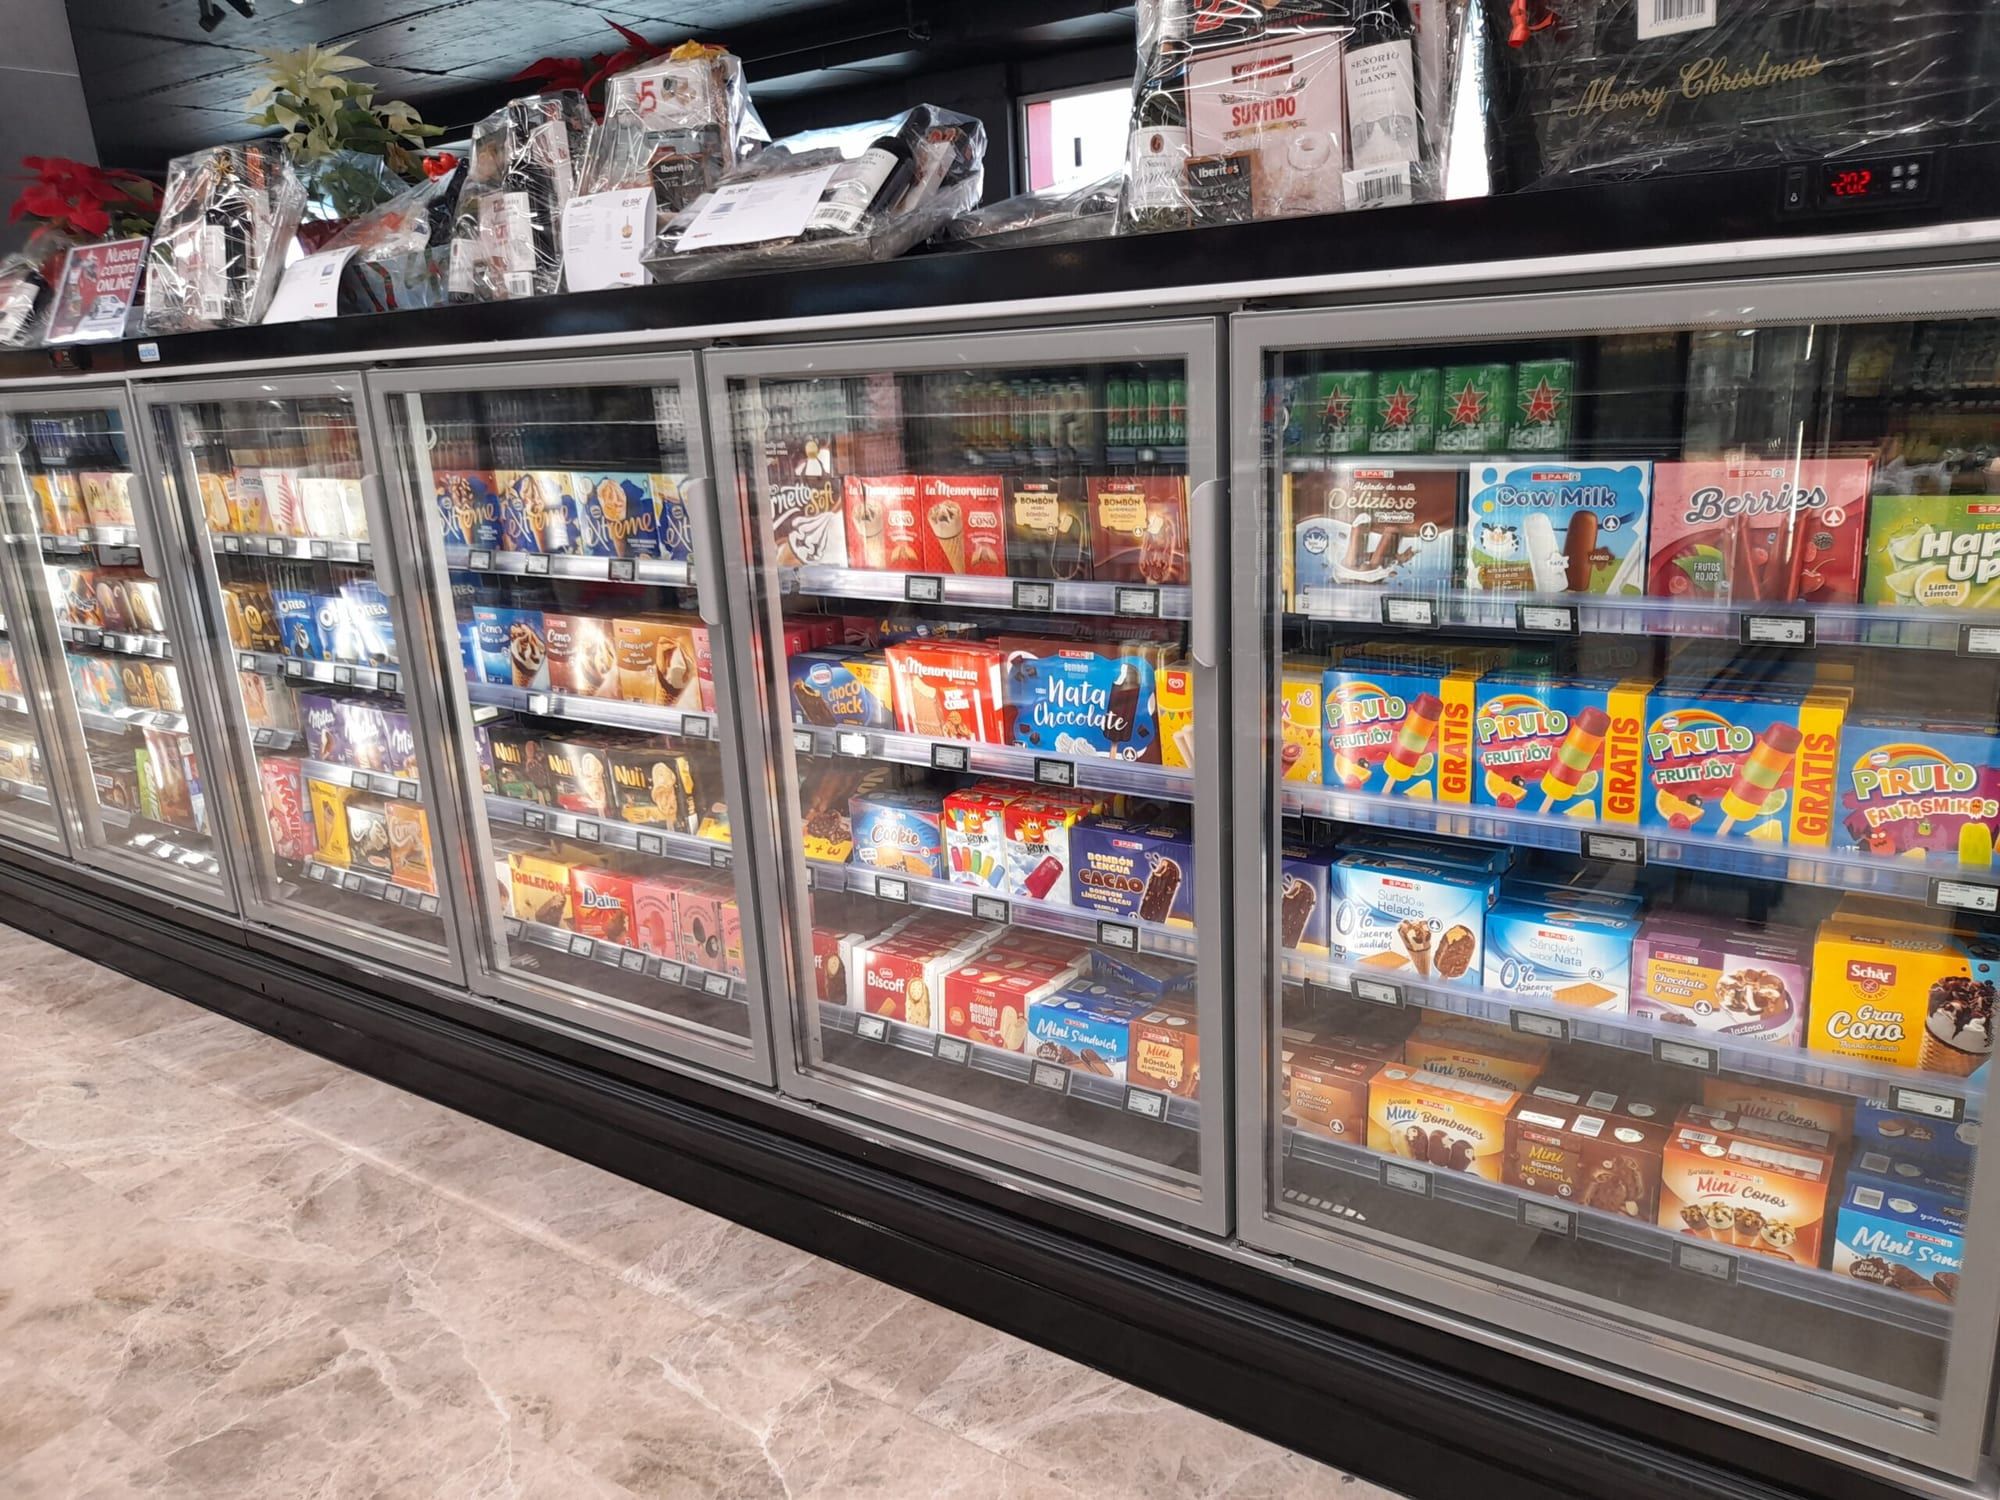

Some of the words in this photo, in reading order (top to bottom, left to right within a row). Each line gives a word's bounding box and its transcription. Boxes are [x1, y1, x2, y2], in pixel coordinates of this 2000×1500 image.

[1355, 71, 1397, 87] LLANOS
[1568, 76, 1668, 117] Merry
[1680, 52, 1824, 98] Christmas
[1232, 96, 1296, 126] SURTIDO
[1199, 165, 1239, 178] Iberitos
[105, 247, 140, 264] Nueva
[100, 262, 136, 277] compra
[96, 276, 134, 292] ONLINE
[1540, 473, 1569, 482] SPAR
[1737, 469, 1771, 478] SPAR
[805, 481, 836, 517] Soft
[935, 480, 999, 499] Menorquina
[1328, 488, 1417, 510] Delizioso
[1496, 485, 1556, 509] Cow
[1560, 485, 1617, 509] Milk
[1020, 496, 1054, 505] BOMBÓN
[1104, 497, 1141, 506] BOMBÓN
[1684, 484, 1829, 525] Berries
[1978, 505, 2000, 513] SPA
[970, 516, 995, 527] CONO
[1920, 530, 2000, 558] Hap
[1693, 562, 1721, 572] FRUTOS
[1695, 572, 1719, 582] ROJOS
[1923, 590, 1959, 598] Limón
[1928, 583, 1956, 591] Lima
[280, 599, 307, 613] OREO
[906, 656, 978, 682] Menorquina
[828, 680, 861, 702] choco
[1049, 675, 1106, 710] Nata
[1297, 690, 1313, 706] x8
[308, 707, 335, 730] Milka
[1033, 702, 1129, 732] Chocolate
[1333, 734, 1368, 748] FRUIT
[1368, 729, 1393, 745] JOY
[494, 742, 522, 764] Nuii
[1441, 703, 1469, 794] GRATIS
[1484, 750, 1525, 767] FRUIT
[1526, 743, 1553, 764] JOY
[614, 764, 646, 788] Nuii
[1607, 717, 1640, 816] GRATIS
[1656, 768, 1701, 784] FRUIT
[1704, 760, 1734, 780] JOY
[1796, 733, 1835, 837] GRATIS
[1864, 796, 2000, 828] FANTASMIKOS
[871, 824, 920, 847] Cookie
[1087, 852, 1134, 868] BOMBÓN
[1090, 860, 1130, 875] LENGUA
[1078, 868, 1145, 894] CACAO
[1388, 880, 1413, 890] SPAR
[582, 887, 620, 909] Daim
[1378, 888, 1416, 907] Surtido
[1377, 901, 1425, 919] Helados
[1554, 953, 1582, 967] Nata
[867, 970, 905, 993] Biscoff
[1654, 973, 1707, 990] Chocolate
[1851, 964, 1892, 983] Schär
[1664, 986, 1693, 997] nata
[1857, 1004, 1904, 1022] Gran
[1036, 1018, 1071, 1039] Mini
[1730, 1023, 1765, 1036] lactosa
[1827, 1010, 1906, 1042] Cono
[1147, 1044, 1172, 1058] Mini
[1848, 1051, 1869, 1060] LATTE
[1143, 1056, 1176, 1070] BOMBÓN
[1456, 1066, 1518, 1092] Bombones
[1386, 1106, 1420, 1121] Mini
[1421, 1111, 1486, 1142] Bombones
[1529, 1145, 1566, 1163] Mini
[1520, 1164, 1573, 1184] NOCCIOLA
[1696, 1175, 1738, 1194] Mini
[1741, 1186, 1787, 1208] Conos
[1851, 1226, 1914, 1256] Mini
